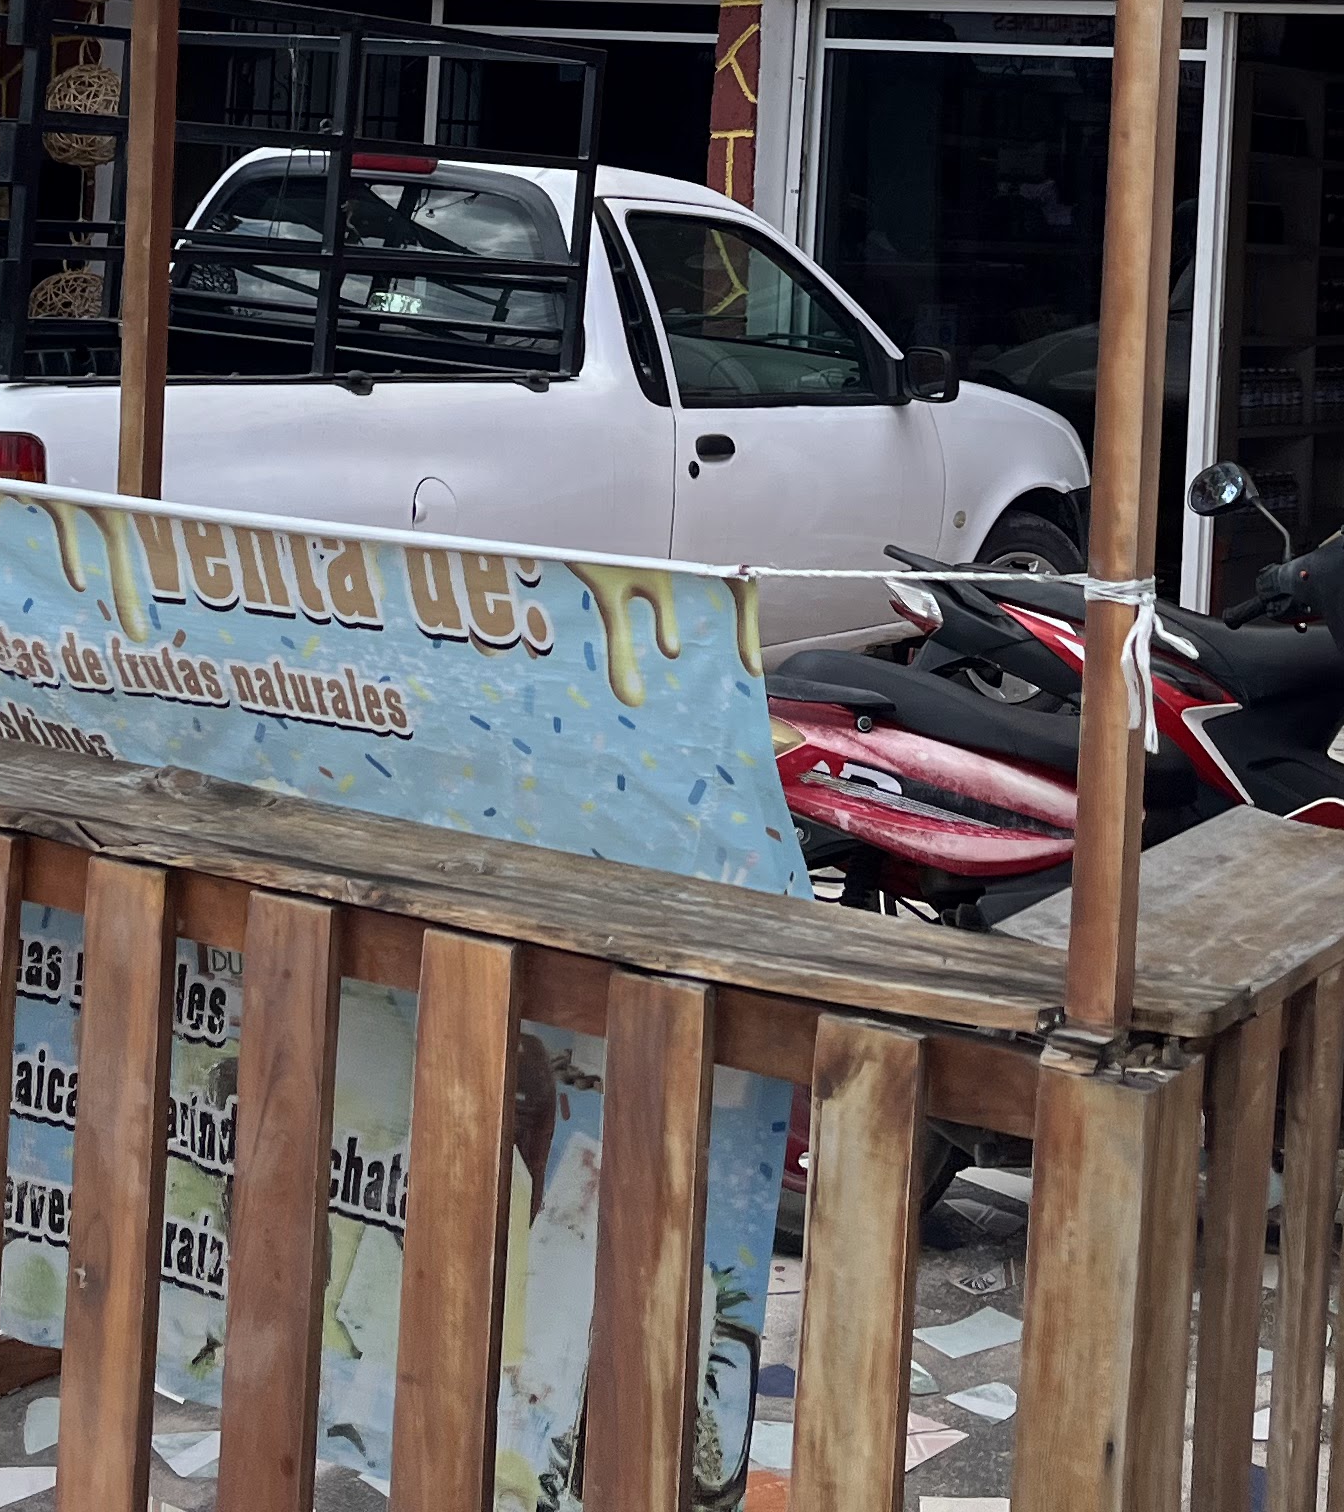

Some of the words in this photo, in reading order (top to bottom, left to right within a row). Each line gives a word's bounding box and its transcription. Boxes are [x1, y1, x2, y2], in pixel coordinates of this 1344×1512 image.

[61, 631, 108, 685] de
[111, 636, 224, 700] frutas
[229, 660, 408, 729] naturales
